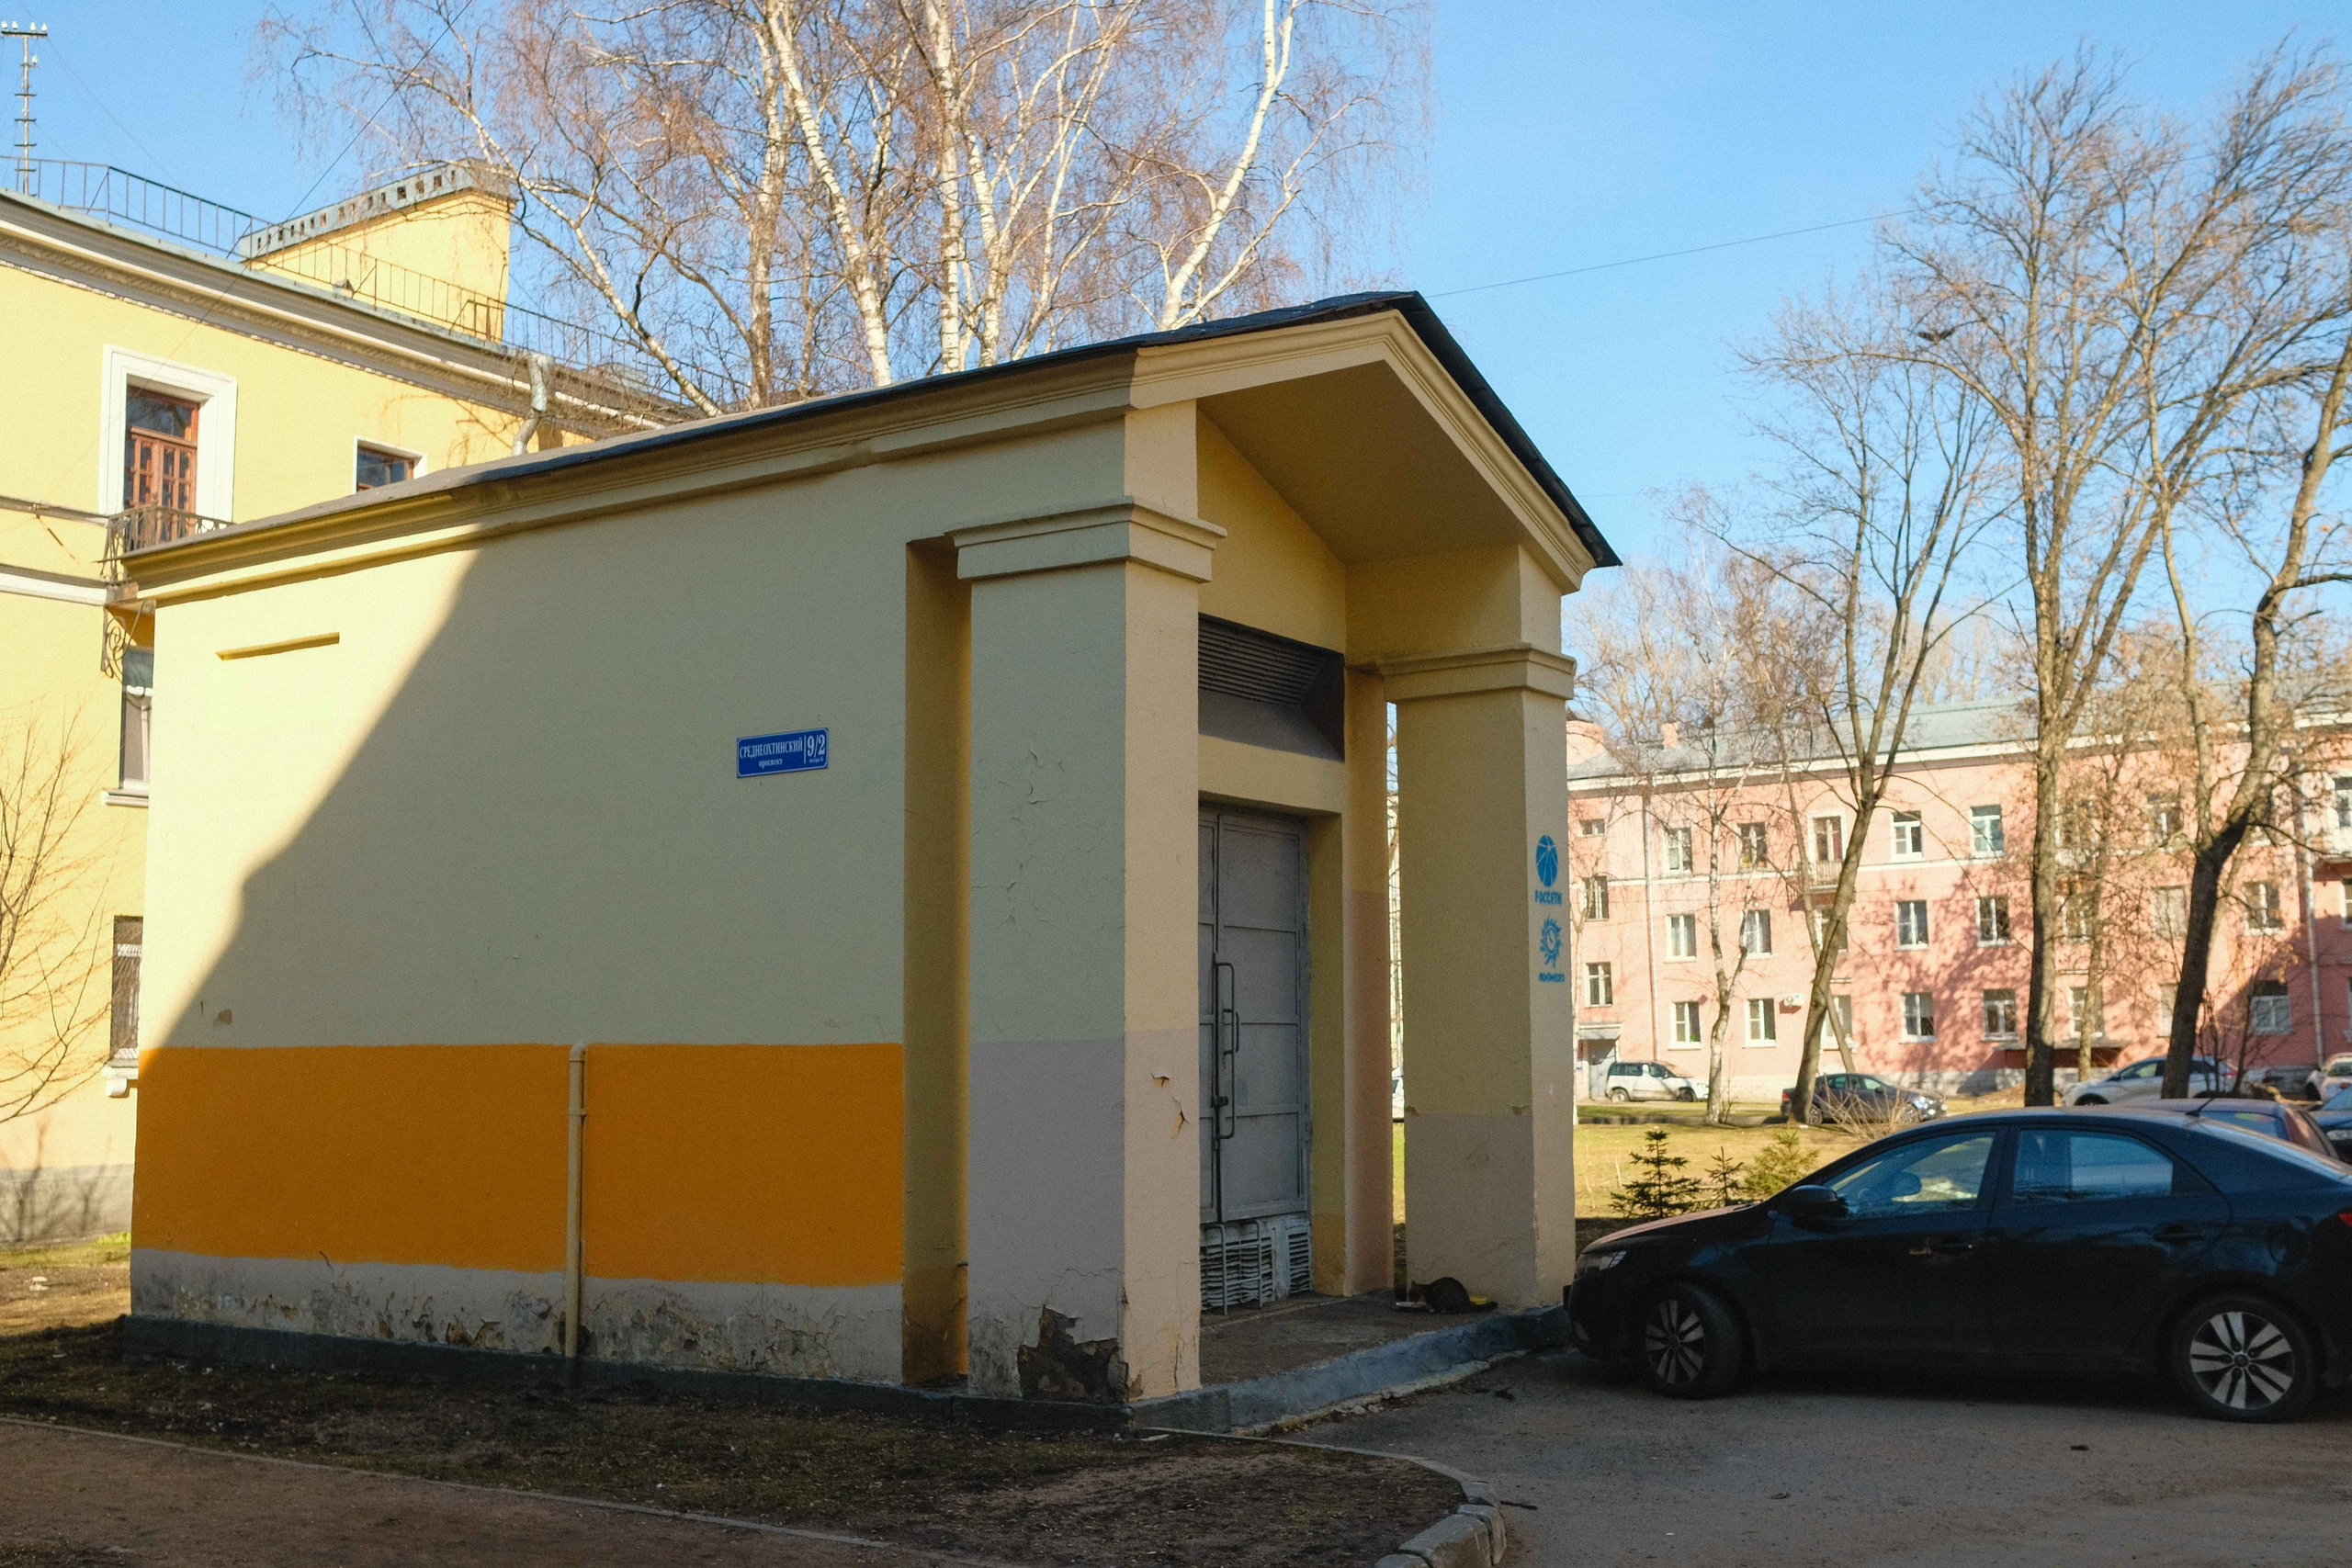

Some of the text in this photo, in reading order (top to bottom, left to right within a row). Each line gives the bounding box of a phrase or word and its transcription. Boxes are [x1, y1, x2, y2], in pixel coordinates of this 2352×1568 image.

[740, 738, 803, 758] СРЕДНЕОХТИНСКИЙ
[807, 734, 826, 758] 9/2
[759, 759, 783, 769] проспект
[1535, 890, 1562, 905] РОССЕТИ
